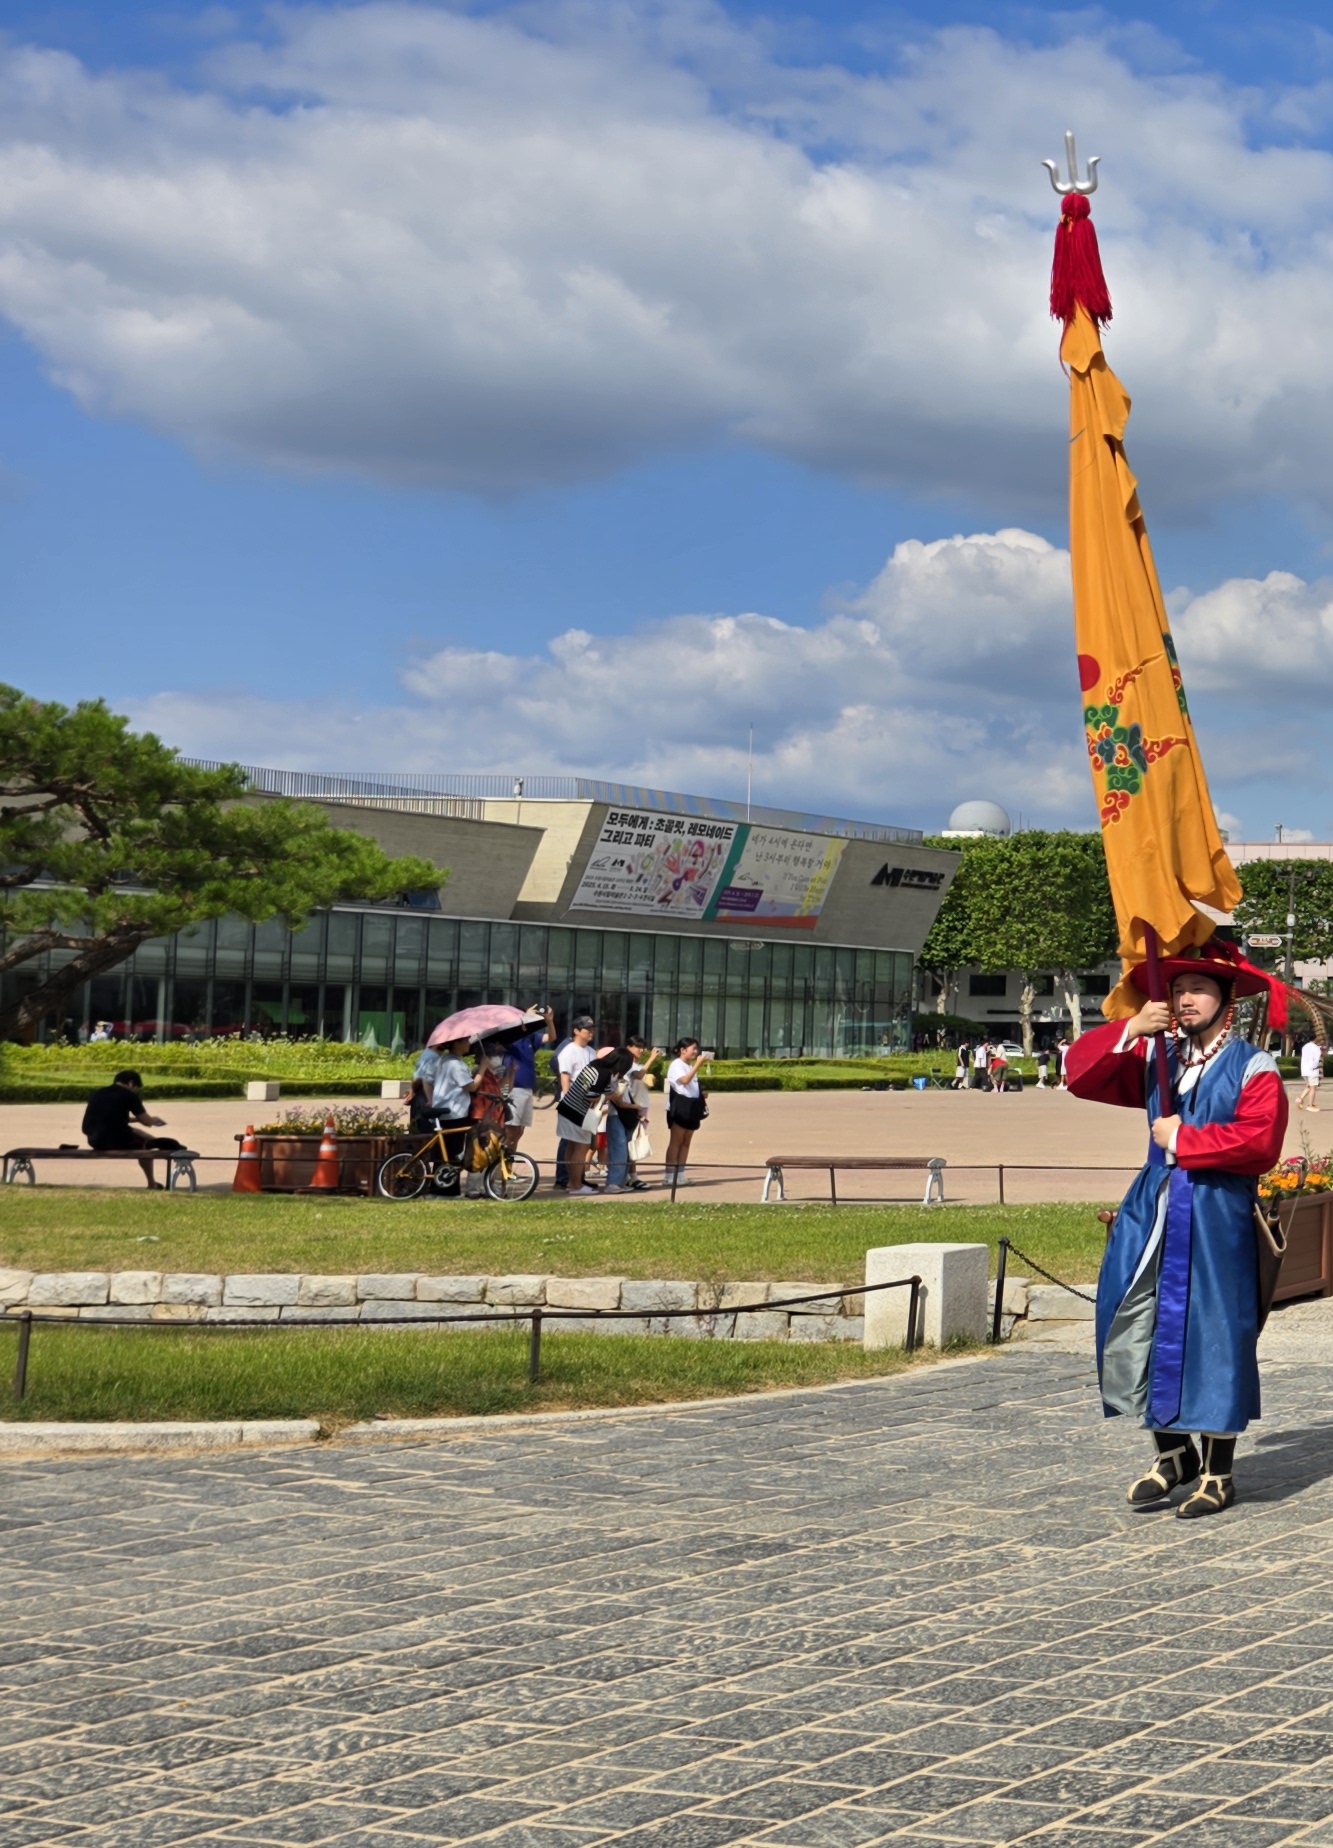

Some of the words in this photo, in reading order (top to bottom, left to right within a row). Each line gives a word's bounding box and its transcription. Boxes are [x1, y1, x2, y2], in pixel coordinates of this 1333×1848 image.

[600, 829, 633, 846] 그리고
[633, 832, 656, 849] 파티
[654, 818, 686, 836] 초콜릿,
[687, 822, 734, 841] 레모네이드
[790, 838, 813, 853] 온다면
